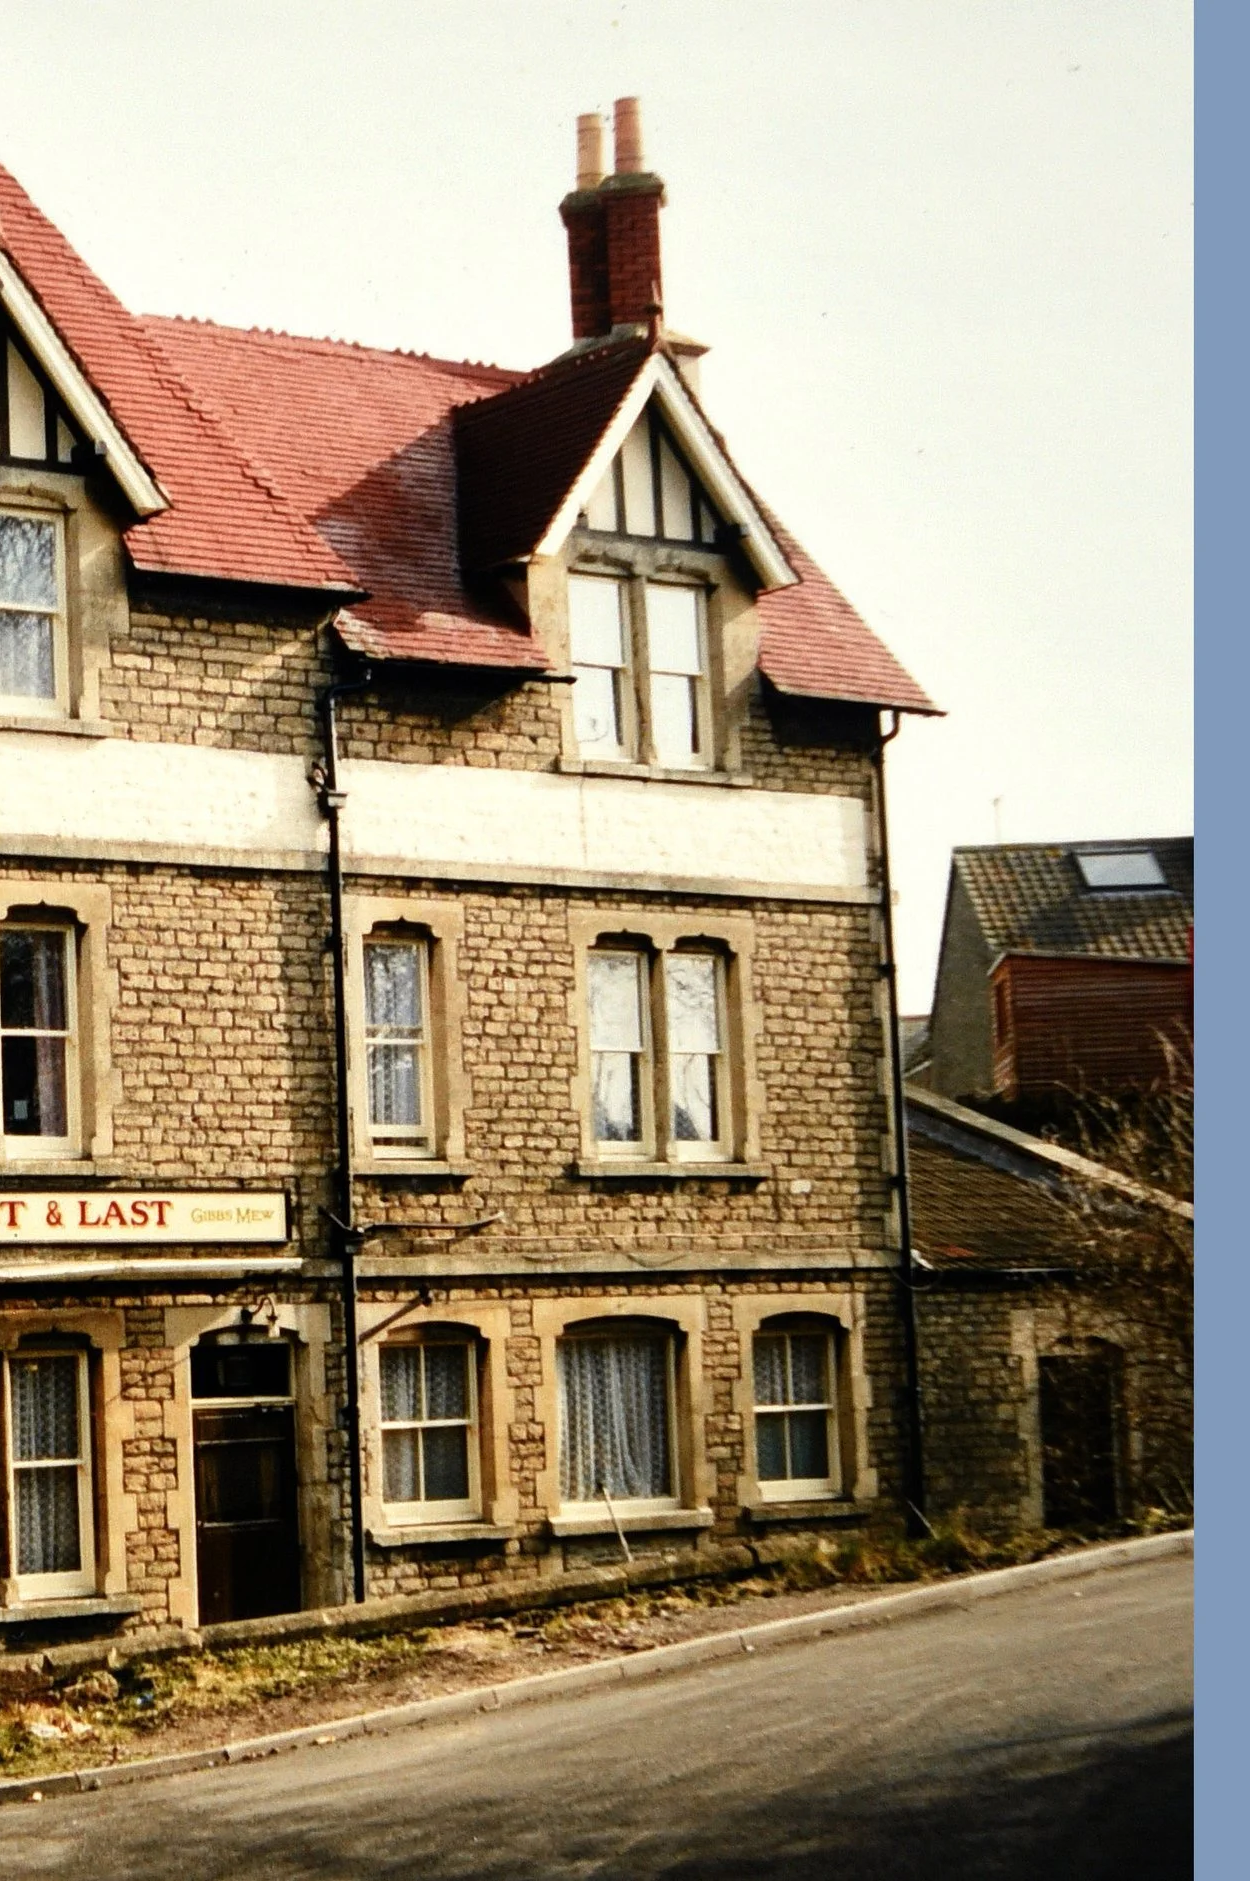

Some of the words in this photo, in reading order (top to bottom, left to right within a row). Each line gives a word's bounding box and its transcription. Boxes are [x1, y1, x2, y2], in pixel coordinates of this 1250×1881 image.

[46, 1200, 63, 1227] &
[78, 1200, 173, 1228] LAST
[191, 1208, 233, 1224] GIBBS
[236, 1206, 275, 1224] MEW
